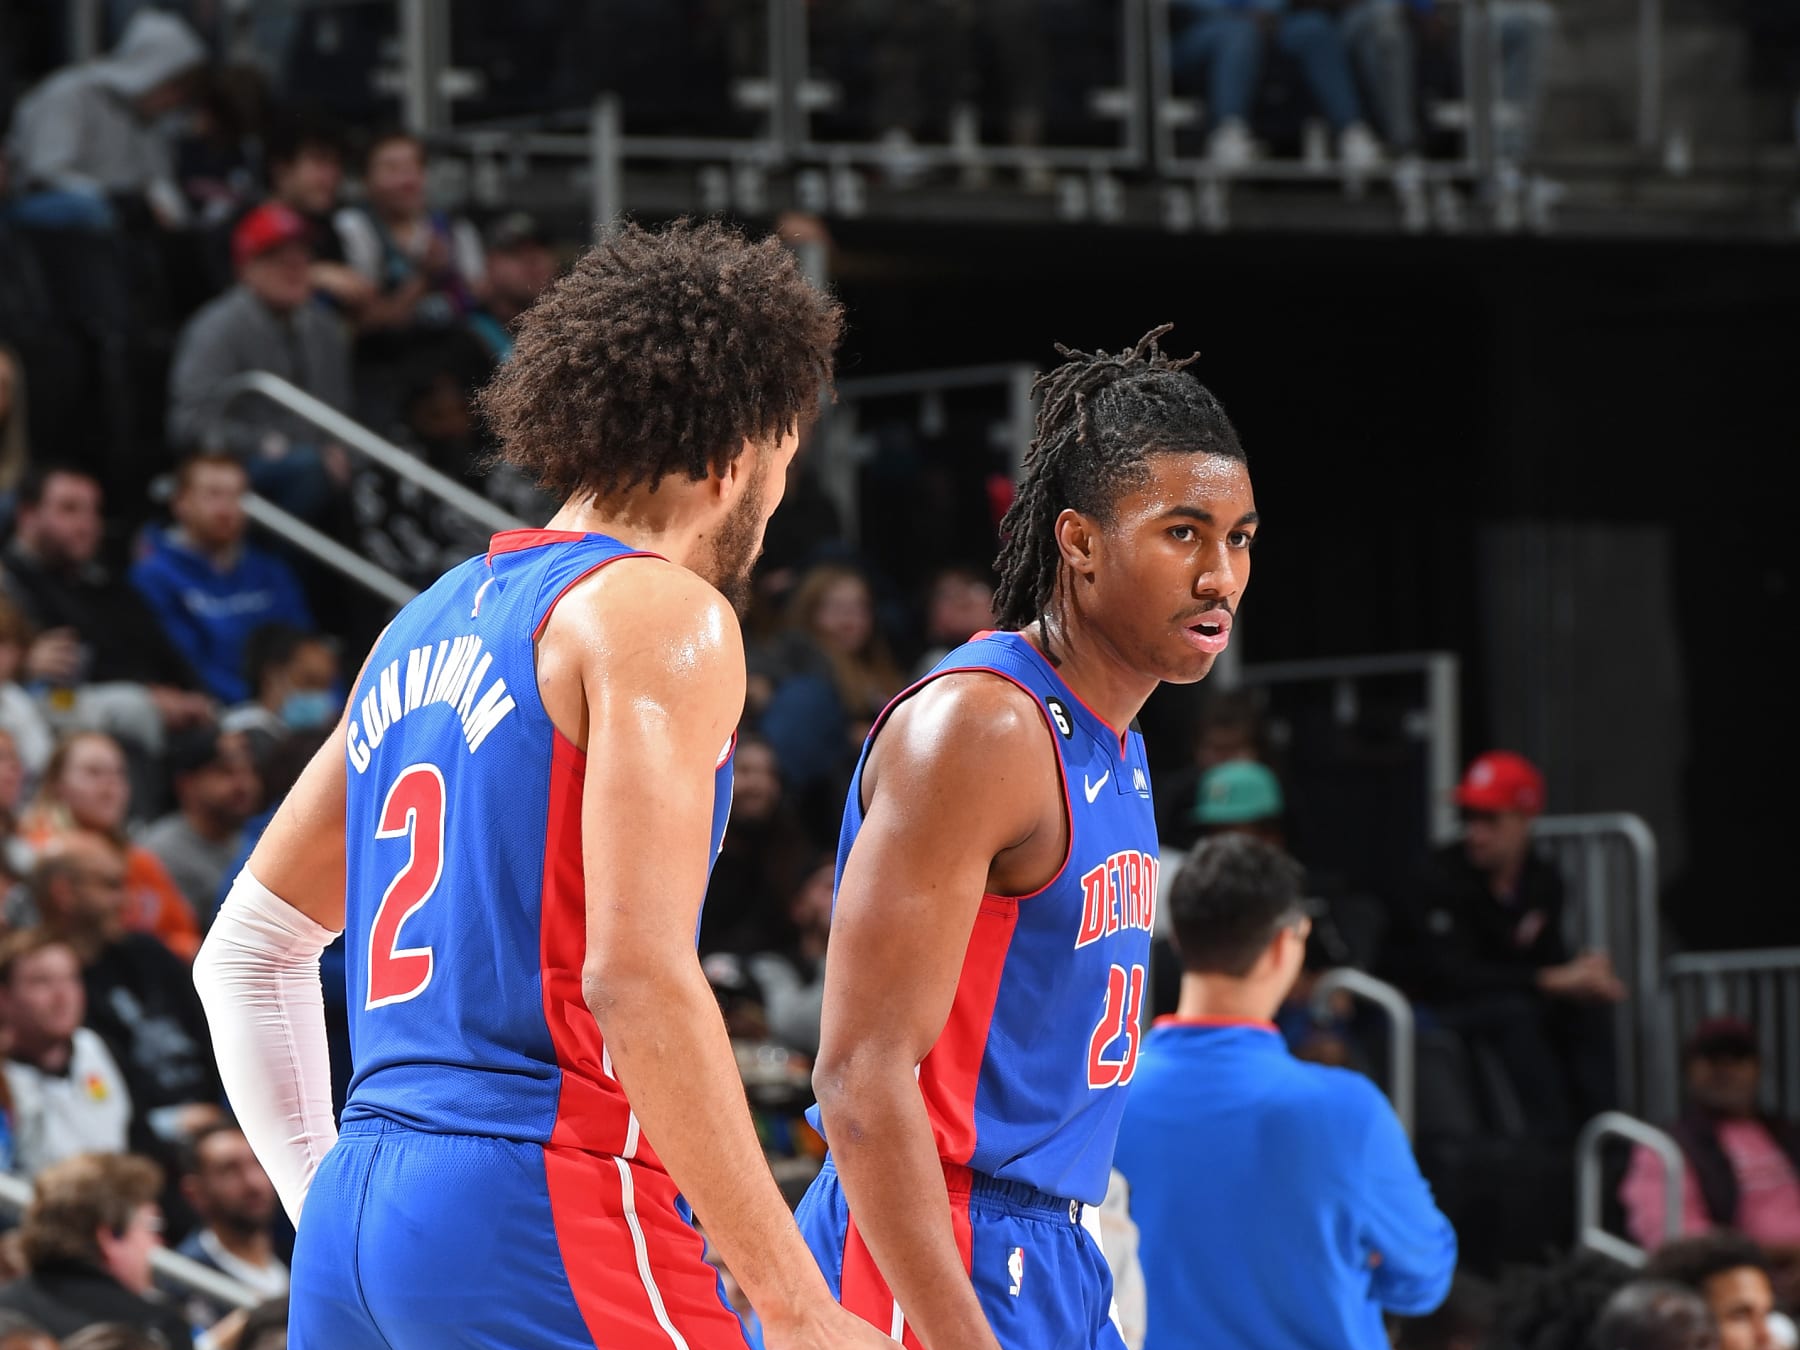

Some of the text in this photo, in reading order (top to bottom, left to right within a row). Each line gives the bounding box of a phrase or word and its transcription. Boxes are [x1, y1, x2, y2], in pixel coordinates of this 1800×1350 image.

[1048, 702, 1070, 734] 6
[365, 763, 446, 1011] 2
[1088, 964, 1145, 1090] 23
